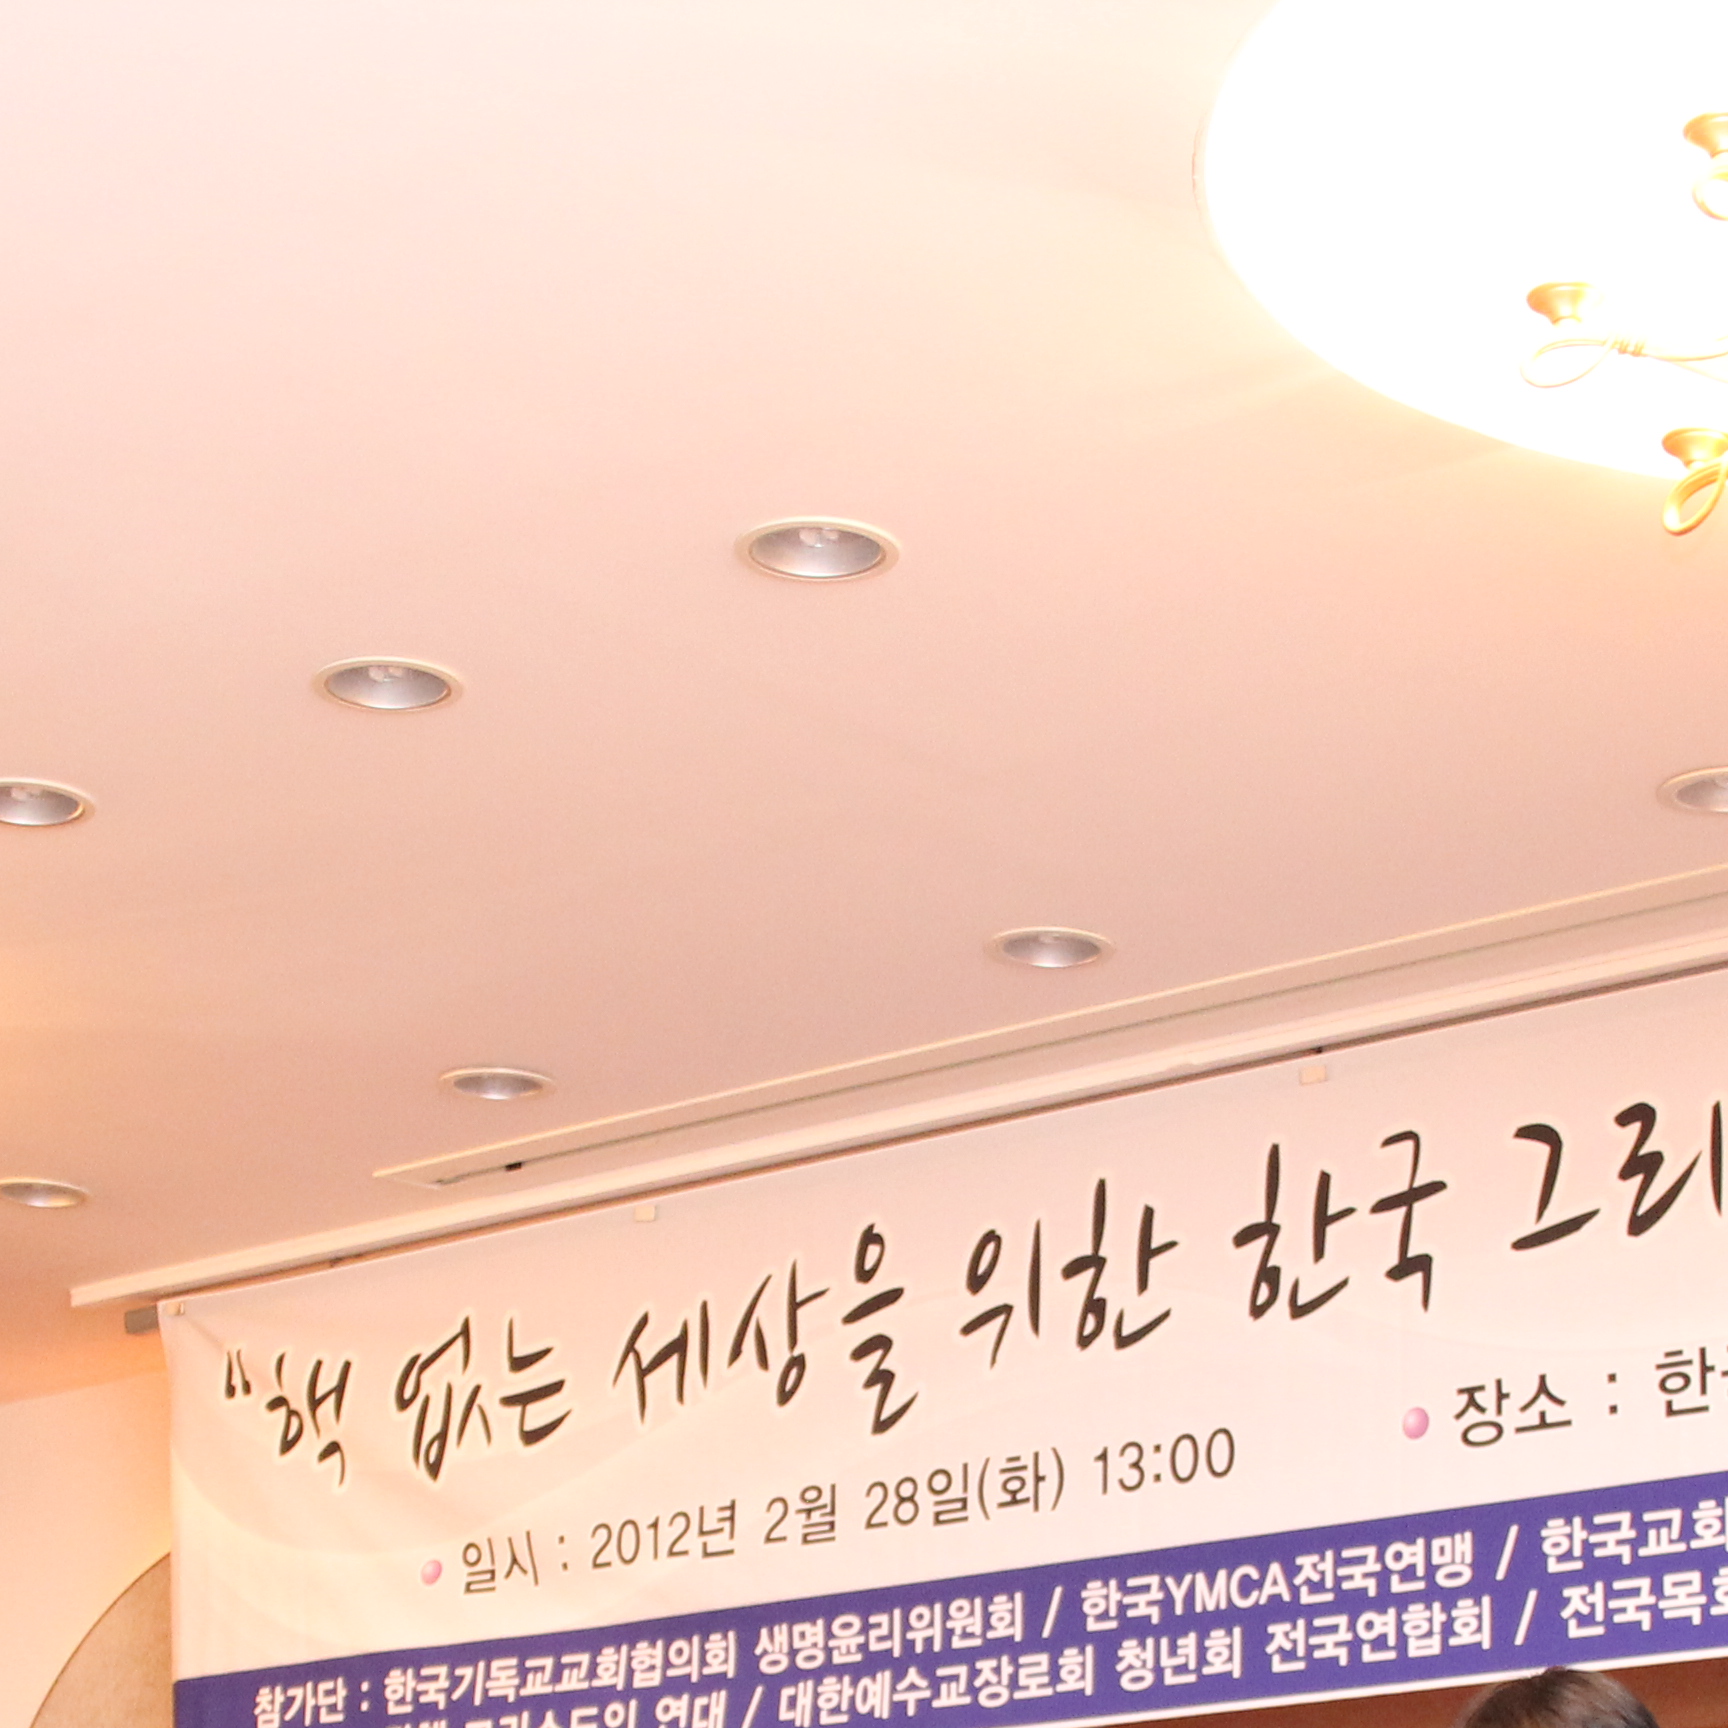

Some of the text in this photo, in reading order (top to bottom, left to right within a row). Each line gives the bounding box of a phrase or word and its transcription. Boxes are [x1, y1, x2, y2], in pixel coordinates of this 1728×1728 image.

[393, 1315, 572, 1483] 없는
[611, 1222, 920, 1436] 세상을
[959, 1177, 1179, 1370] 위한
[1232, 1129, 1447, 1322] 한국
[1453, 1371, 1573, 1447] 장소
[461, 1530, 540, 1594] 일시
[590, 1499, 737, 1570] 2012년
[763, 1482, 838, 1546] 2월
[863, 1446, 1066, 1532] 28일(화)
[1093, 1426, 1235, 1496] 13:00
[383, 1630, 737, 1717] 한국기독교교회협의회
[753, 1591, 1025, 1675] 생명윤리위원회
[1080, 1530, 1474, 1635] 한국YMCA전국연맹
[778, 1645, 1095, 1728] 대한예수교장로회
[1115, 1626, 1243, 1692] 청년회
[1265, 1595, 1491, 1673] 전국연합회
